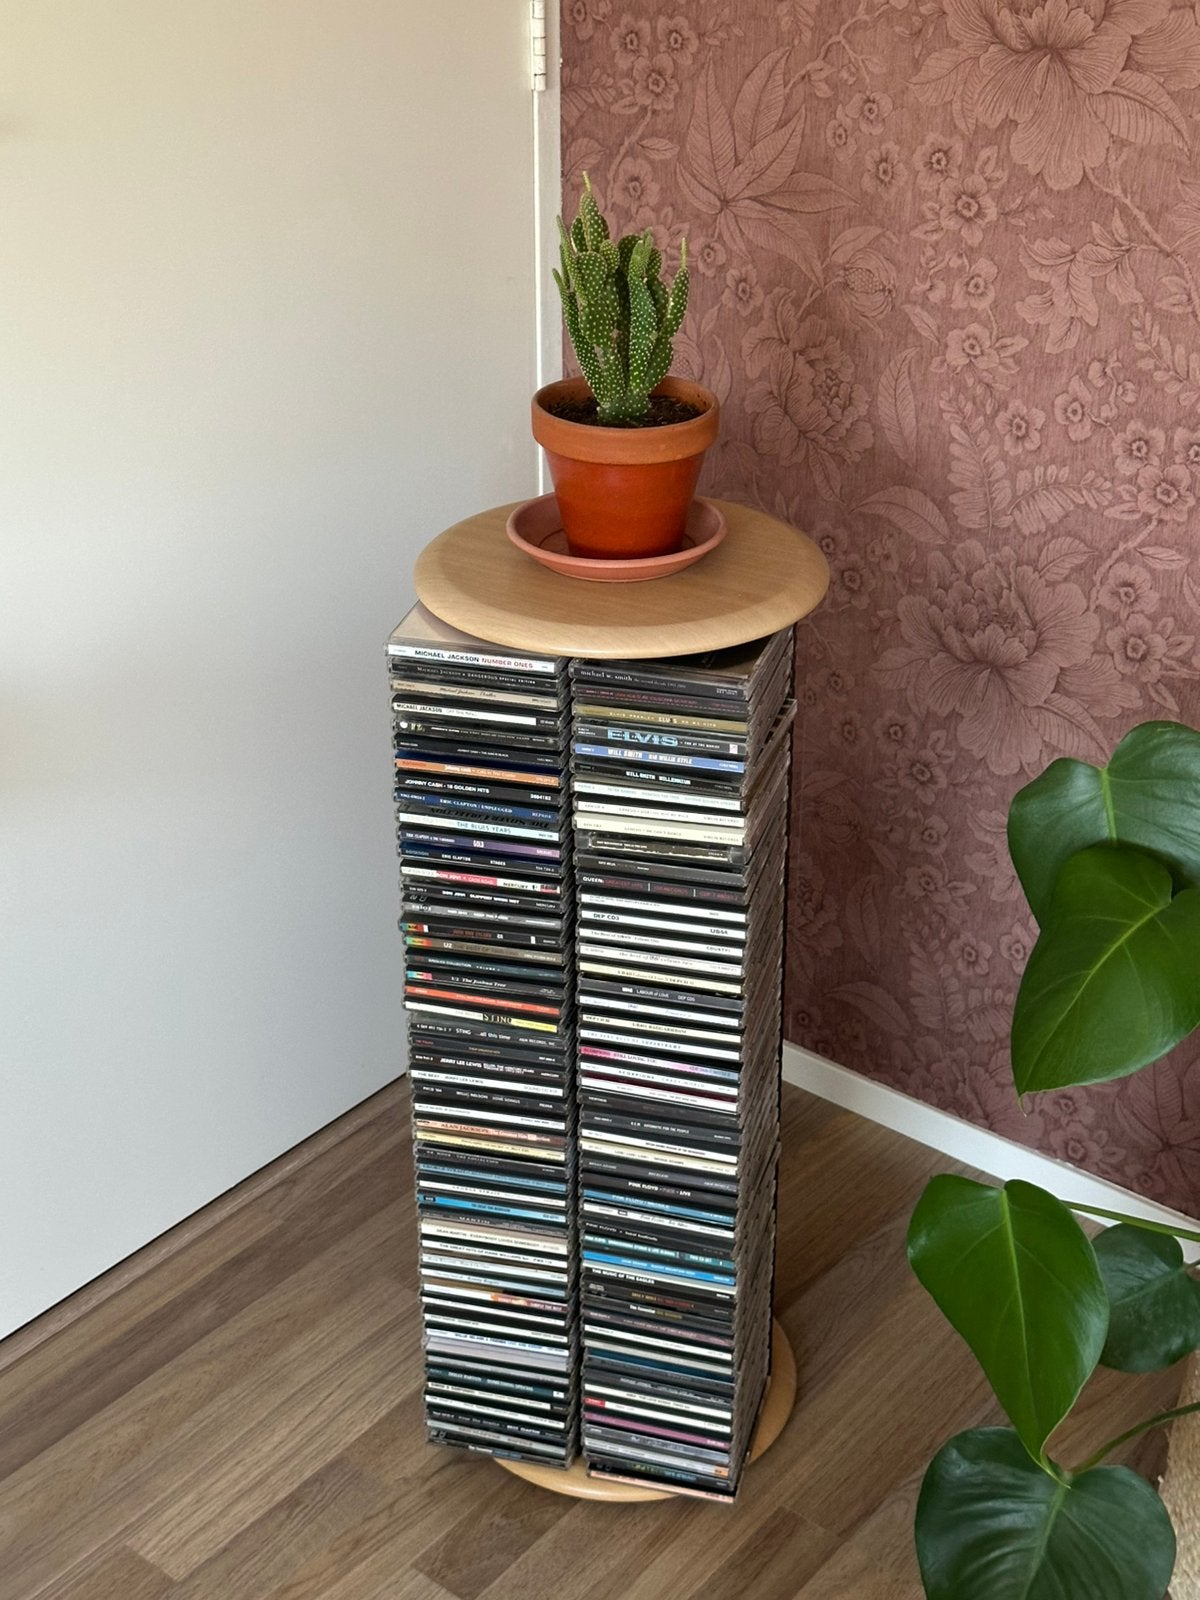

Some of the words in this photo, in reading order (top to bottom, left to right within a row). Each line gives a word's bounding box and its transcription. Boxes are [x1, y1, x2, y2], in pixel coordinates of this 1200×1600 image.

[415, 650, 445, 658] MICHAEL
[448, 654, 479, 662] JACKSON
[482, 658, 512, 666] NUMBER
[580, 669, 604, 678] michael
[396, 703, 417, 711] MICHAEL
[418, 705, 442, 713] JACKSON
[607, 727, 679, 747] ELVIS
[608, 749, 623, 757] WILL
[624, 750, 643, 759] SMITH
[659, 754, 676, 762] WILLIE
[677, 756, 693, 764] STYLE
[454, 784, 476, 792] GOLDEN
[471, 823, 489, 831] BLUES
[460, 1125, 489, 1133] JACKSON
[642, 1183, 658, 1191] FLOYD
[636, 1276, 655, 1284] EAGLES
